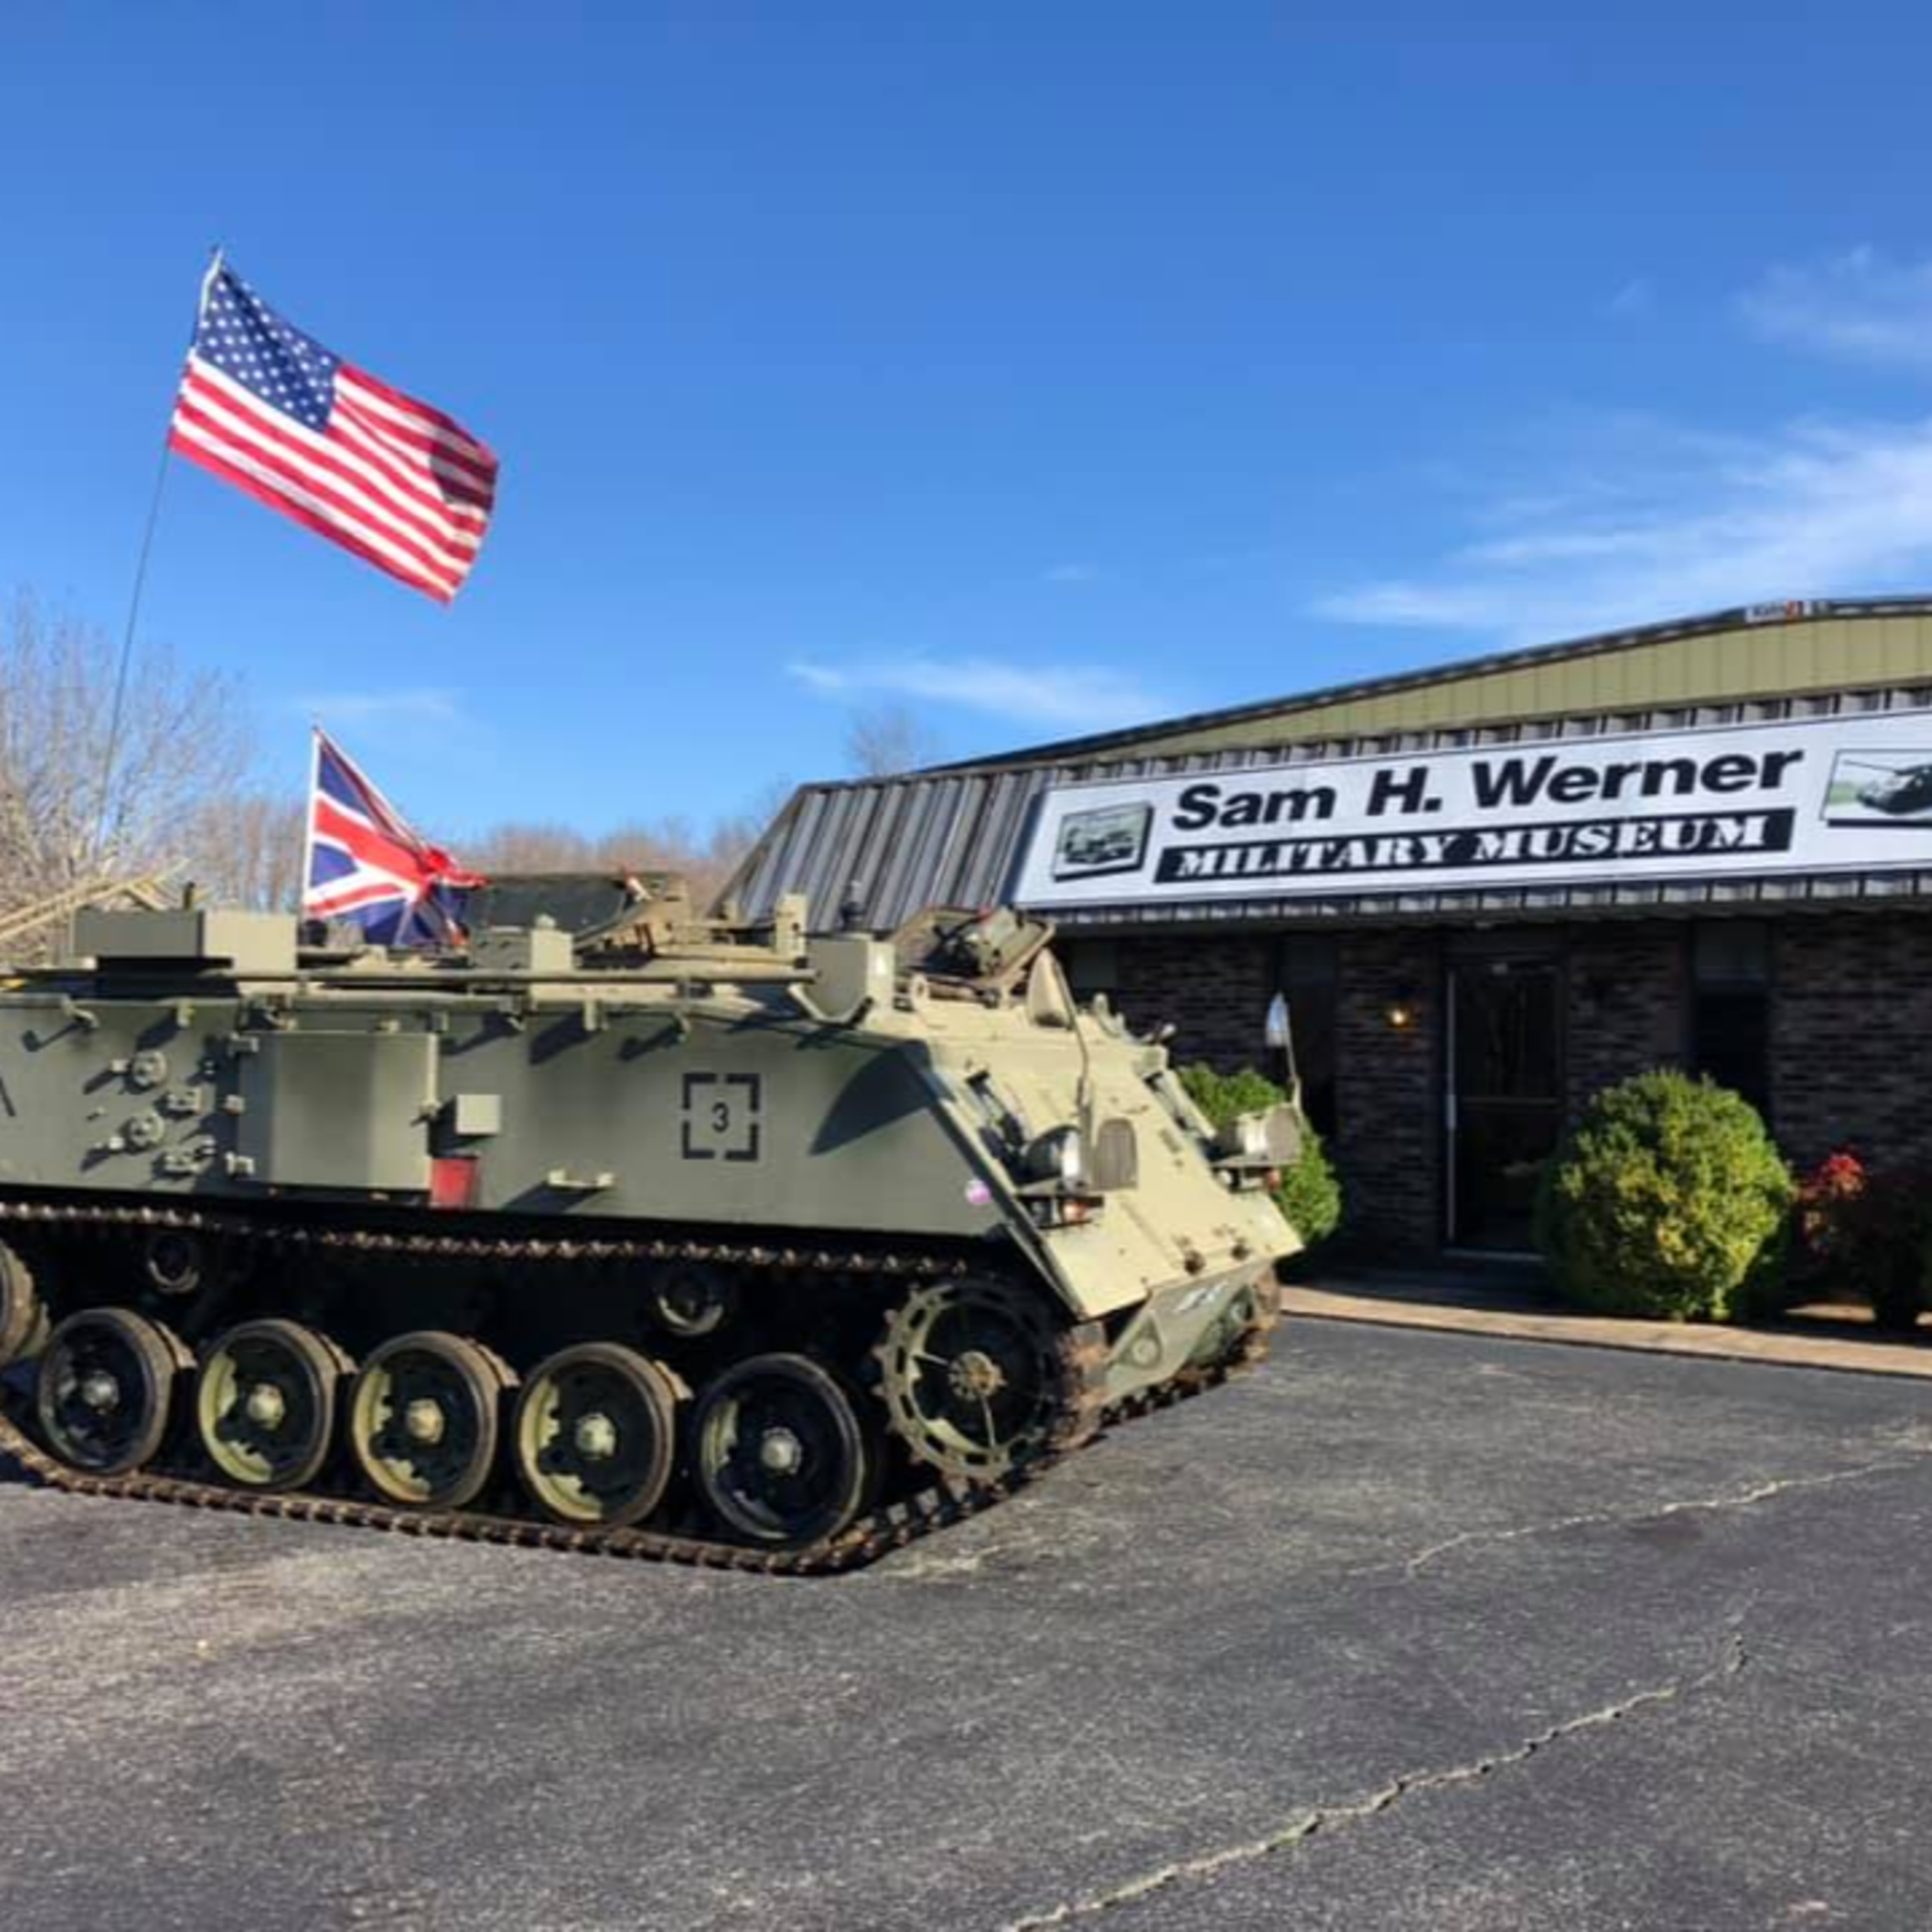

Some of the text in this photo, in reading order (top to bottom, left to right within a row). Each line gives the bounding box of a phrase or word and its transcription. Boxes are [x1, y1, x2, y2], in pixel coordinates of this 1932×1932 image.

[1171, 749, 1804, 831] Sam H. Werner
[1176, 815, 1769, 877] MILITARY MUSEUM
[712, 1102, 729, 1133] 3
